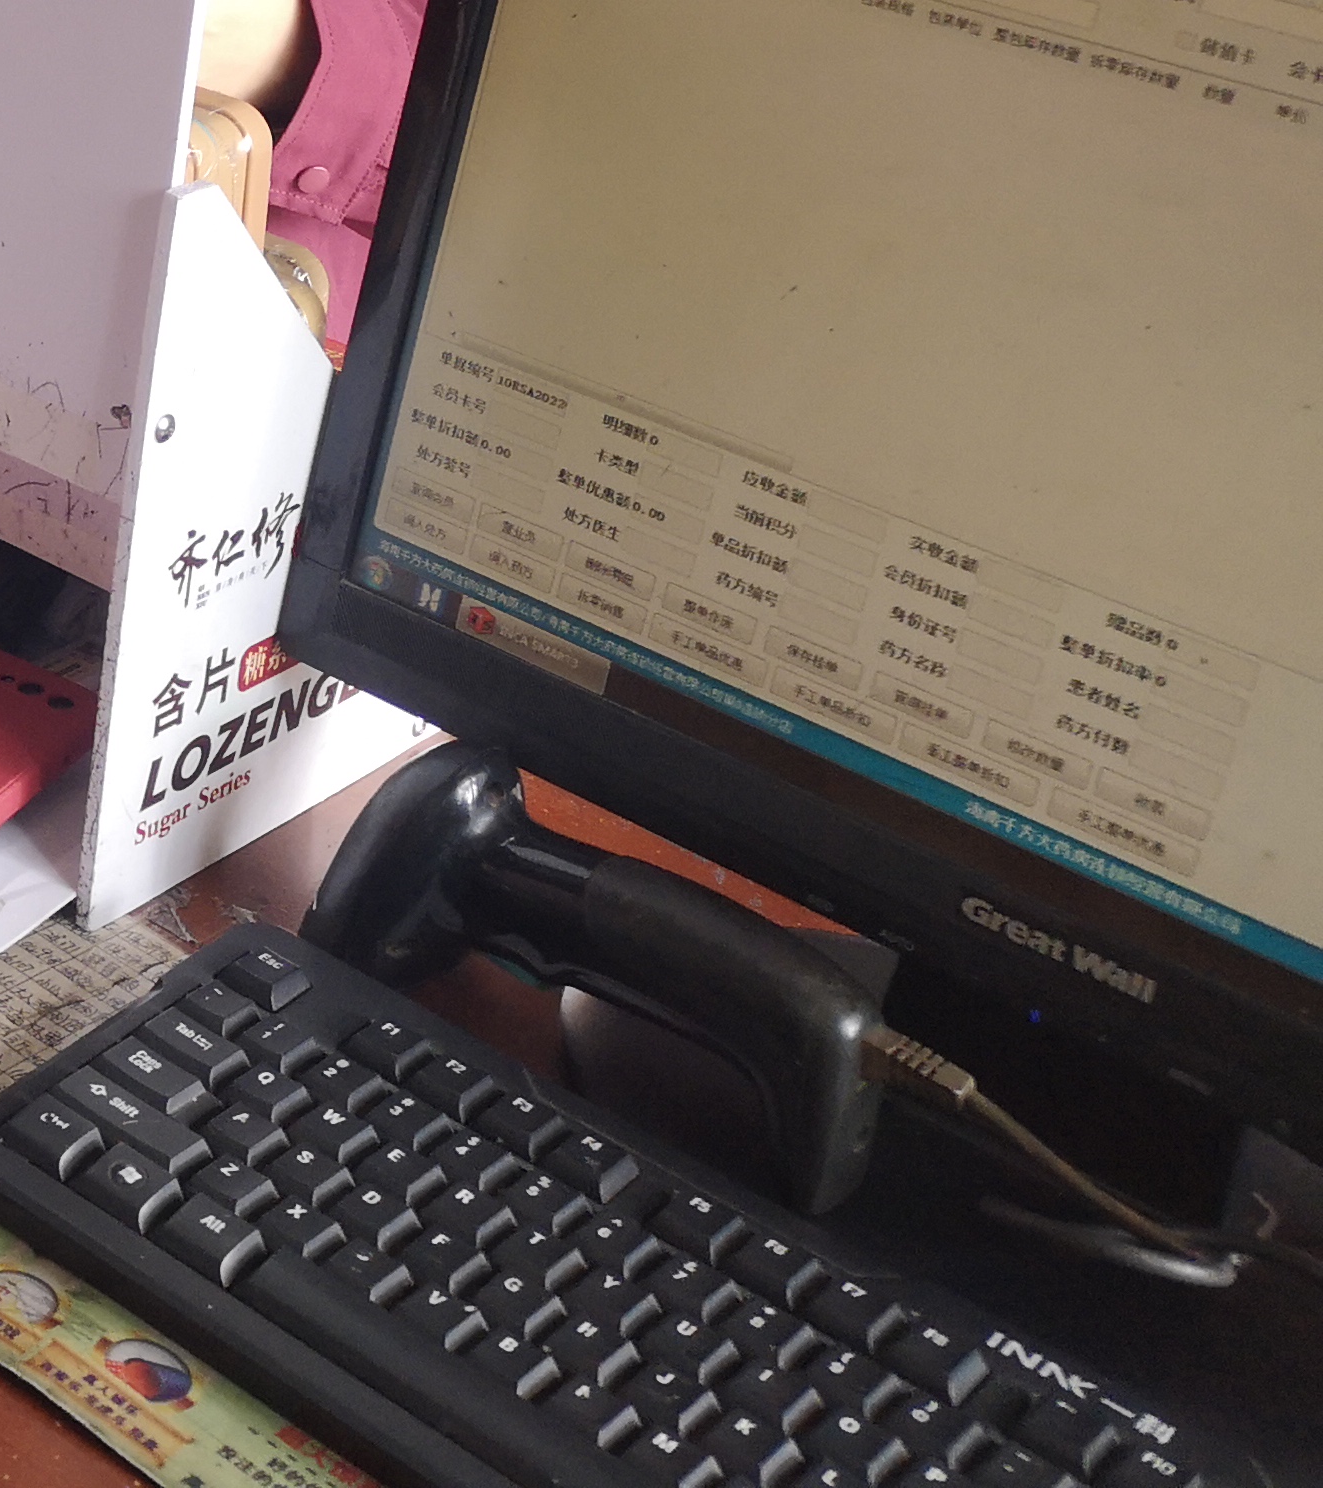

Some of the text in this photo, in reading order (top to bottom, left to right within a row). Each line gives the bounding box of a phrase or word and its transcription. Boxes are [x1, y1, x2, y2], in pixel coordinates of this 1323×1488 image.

[432, 382, 487, 415] 会员卡号
[595, 449, 641, 477] 卡类型
[734, 504, 797, 540] 当前积分
[439, 350, 495, 384] 单据编号
[742, 470, 808, 507] 应收金额
[909, 535, 979, 574] 实收金额
[411, 408, 480, 449] 整单折扣额
[557, 468, 632, 510] 整单优惠额
[711, 532, 789, 574] 单品折扣额
[890, 605, 957, 644] 身份证号
[563, 506, 622, 543] 处方医生
[715, 571, 779, 608] 药方编号
[151, 647, 236, 738] 含片
[134, 768, 253, 846] Sugar Series
[961, 897, 1066, 962] Great
[1073, 943, 1156, 1004] Wall
[257, 953, 283, 970] Esc
[175, 1021, 195, 1041] Tab
[380, 1021, 400, 1036] F1
[445, 1058, 467, 1074] F2
[257, 1071, 275, 1085] Q
[109, 1097, 140, 1118] Shift
[512, 1096, 534, 1113] F3
[231, 1112, 250, 1124] A
[322, 1109, 346, 1125] W
[581, 1135, 603, 1152] F4
[295, 1150, 315, 1164] S
[387, 1148, 407, 1163] E
[219, 1163, 240, 1177] Z
[361, 1190, 382, 1205] D
[455, 1188, 475, 1204] R
[286, 1203, 308, 1219] X
[689, 1197, 713, 1213] F5
[199, 1214, 227, 1233] Alt
[430, 1232, 451, 1246] F
[529, 1231, 547, 1246] T
[764, 1238, 790, 1255] F6
[503, 1277, 524, 1292] G
[601, 1274, 622, 1290] Y
[841, 1281, 868, 1298] F7
[429, 1290, 448, 1305] V
[576, 1321, 598, 1339] H
[676, 1319, 698, 1337] U
[498, 1336, 519, 1352] B
[734, 1417, 756, 1436] K
[838, 1416, 861, 1435] O
